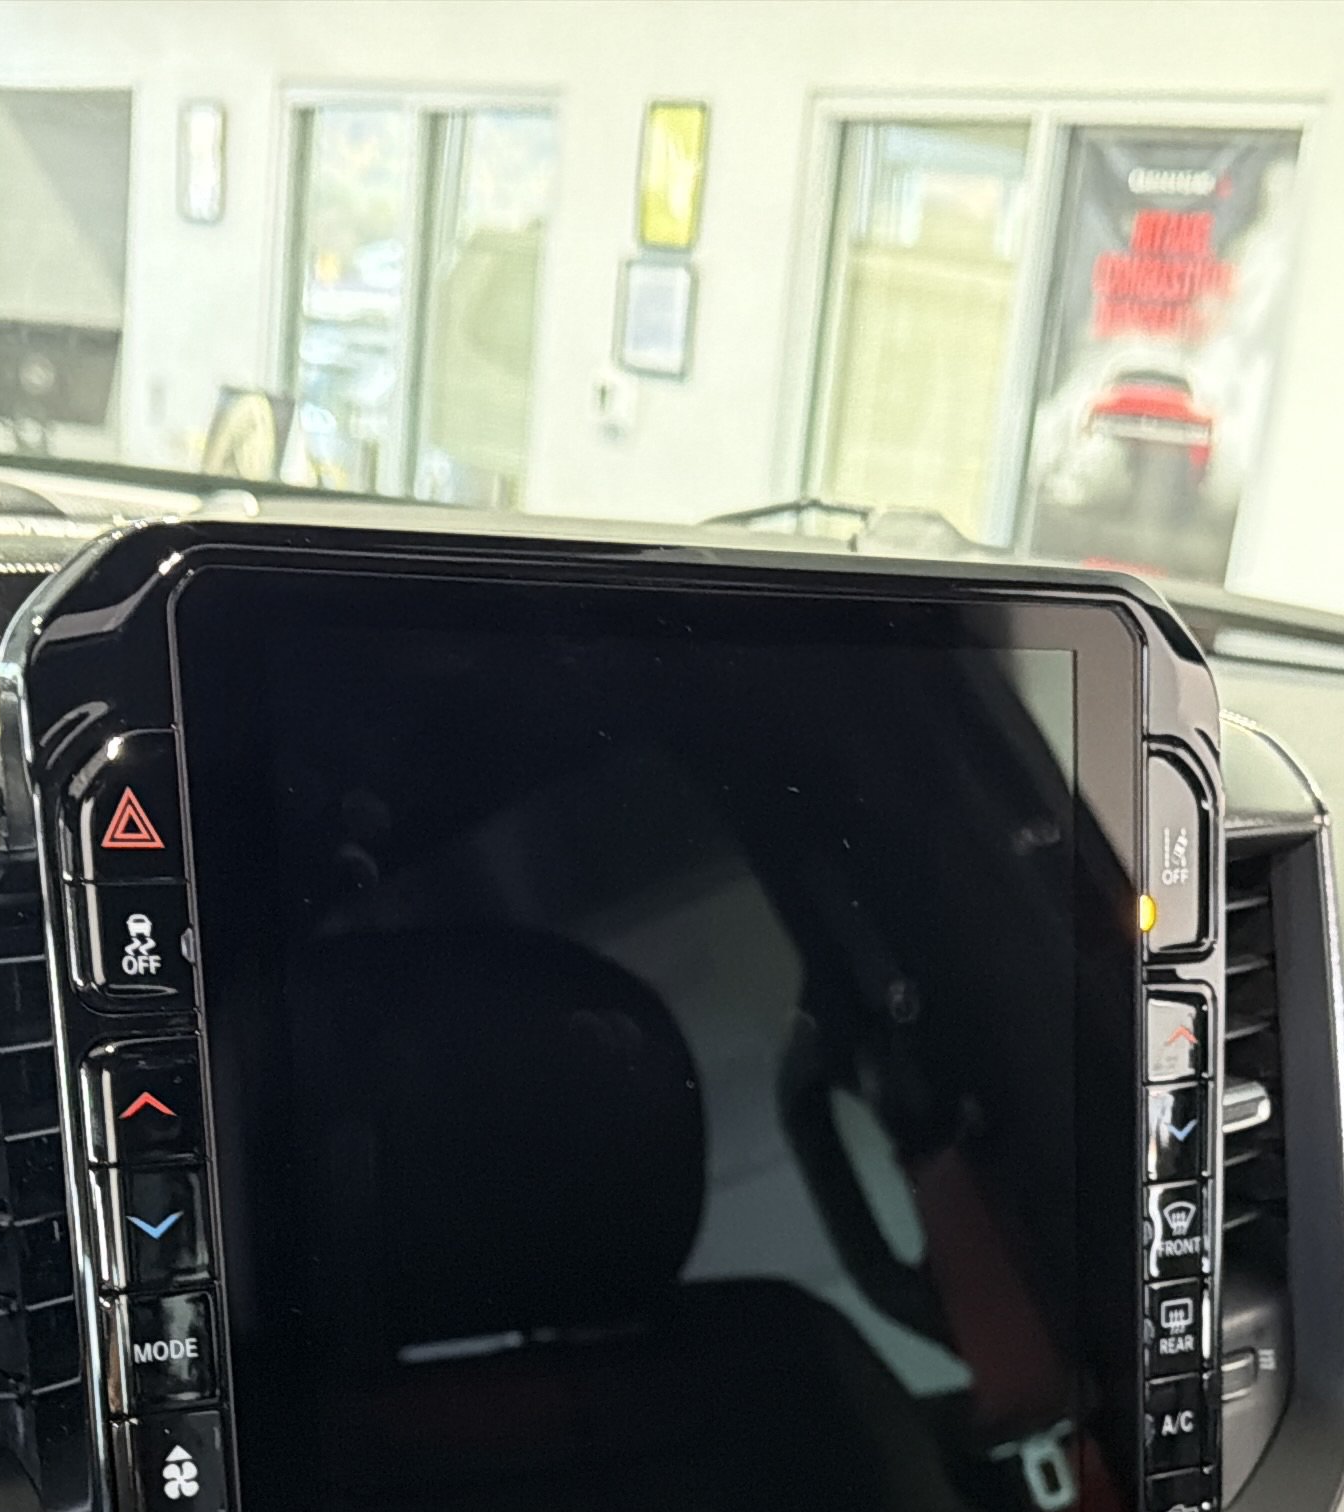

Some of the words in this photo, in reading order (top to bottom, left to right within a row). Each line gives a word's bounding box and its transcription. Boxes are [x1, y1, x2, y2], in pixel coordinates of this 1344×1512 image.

[122, 955, 162, 975] OFF
[1157, 1235, 1201, 1258] FRONT
[133, 1337, 199, 1364] MODE
[1159, 1334, 1195, 1355] REAR
[1161, 1410, 1195, 1436] A/C
